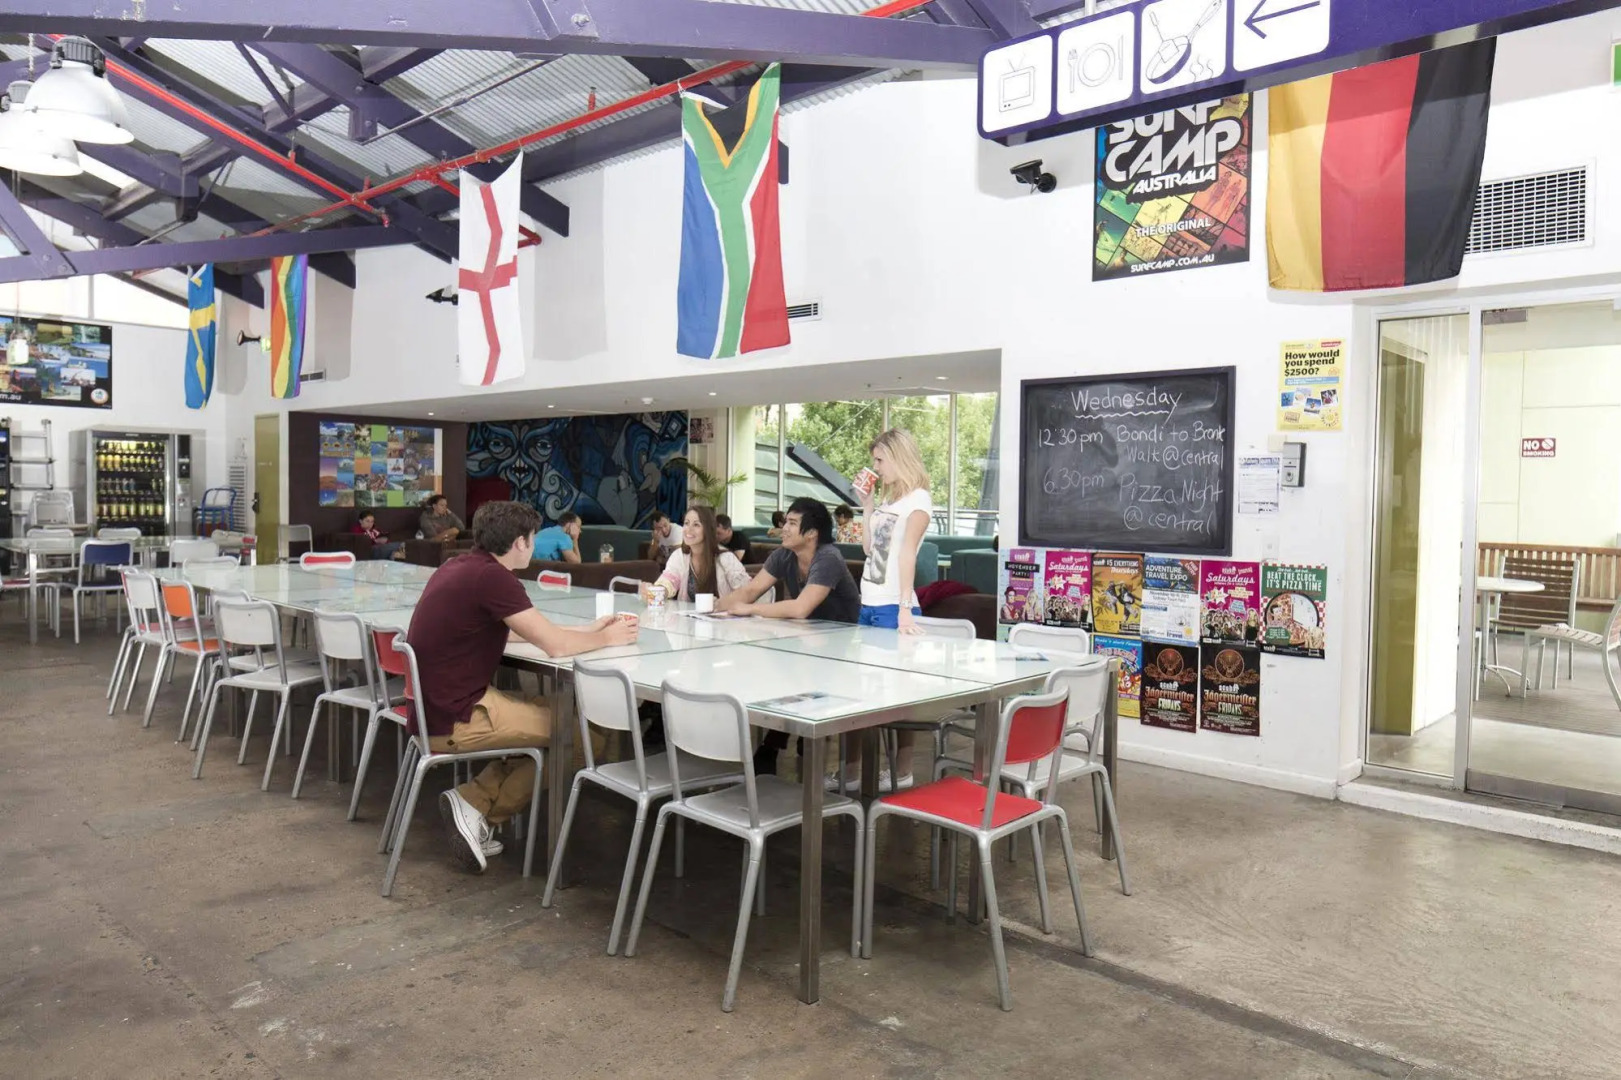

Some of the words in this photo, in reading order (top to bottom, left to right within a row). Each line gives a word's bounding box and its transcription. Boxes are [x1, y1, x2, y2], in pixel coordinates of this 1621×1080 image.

[1105, 120, 1241, 182] CAMP
[1133, 165, 1217, 194] AUSTRALIA
[1135, 226, 1156, 238] THE
[1156, 217, 1211, 234] ORIGINAL
[1131, 254, 1215, 273] SURFCAMP.COM.AU
[1285, 352, 1307, 361] How
[1308, 349, 1340, 360] would
[1285, 360, 1303, 368] you
[1304, 357, 1335, 367] spend
[1285, 367, 1320, 377] $2500?
[1072, 386, 1183, 426] Wednesday
[1117, 424, 1164, 443] Bondi
[1168, 423, 1189, 442] to
[1523, 440, 1540, 450] NO
[1126, 445, 1160, 464] Walk
[1007, 563, 1037, 571] NOVEMBER
[1048, 561, 1089, 573] Saturdays
[1145, 564, 1182, 574] ADVENTURE
[1145, 571, 1169, 580] TRAVEL
[1205, 572, 1255, 586] Saturdays
[1266, 571, 1282, 580] BEAT
[1284, 572, 1295, 581] THE
[1266, 579, 1280, 589] IT'S
[1282, 580, 1303, 590] PIZZA
[1305, 581, 1322, 591] TIME
[1158, 698, 1181, 711] FRIDAYS
[1218, 701, 1242, 714] FRIDAYS
